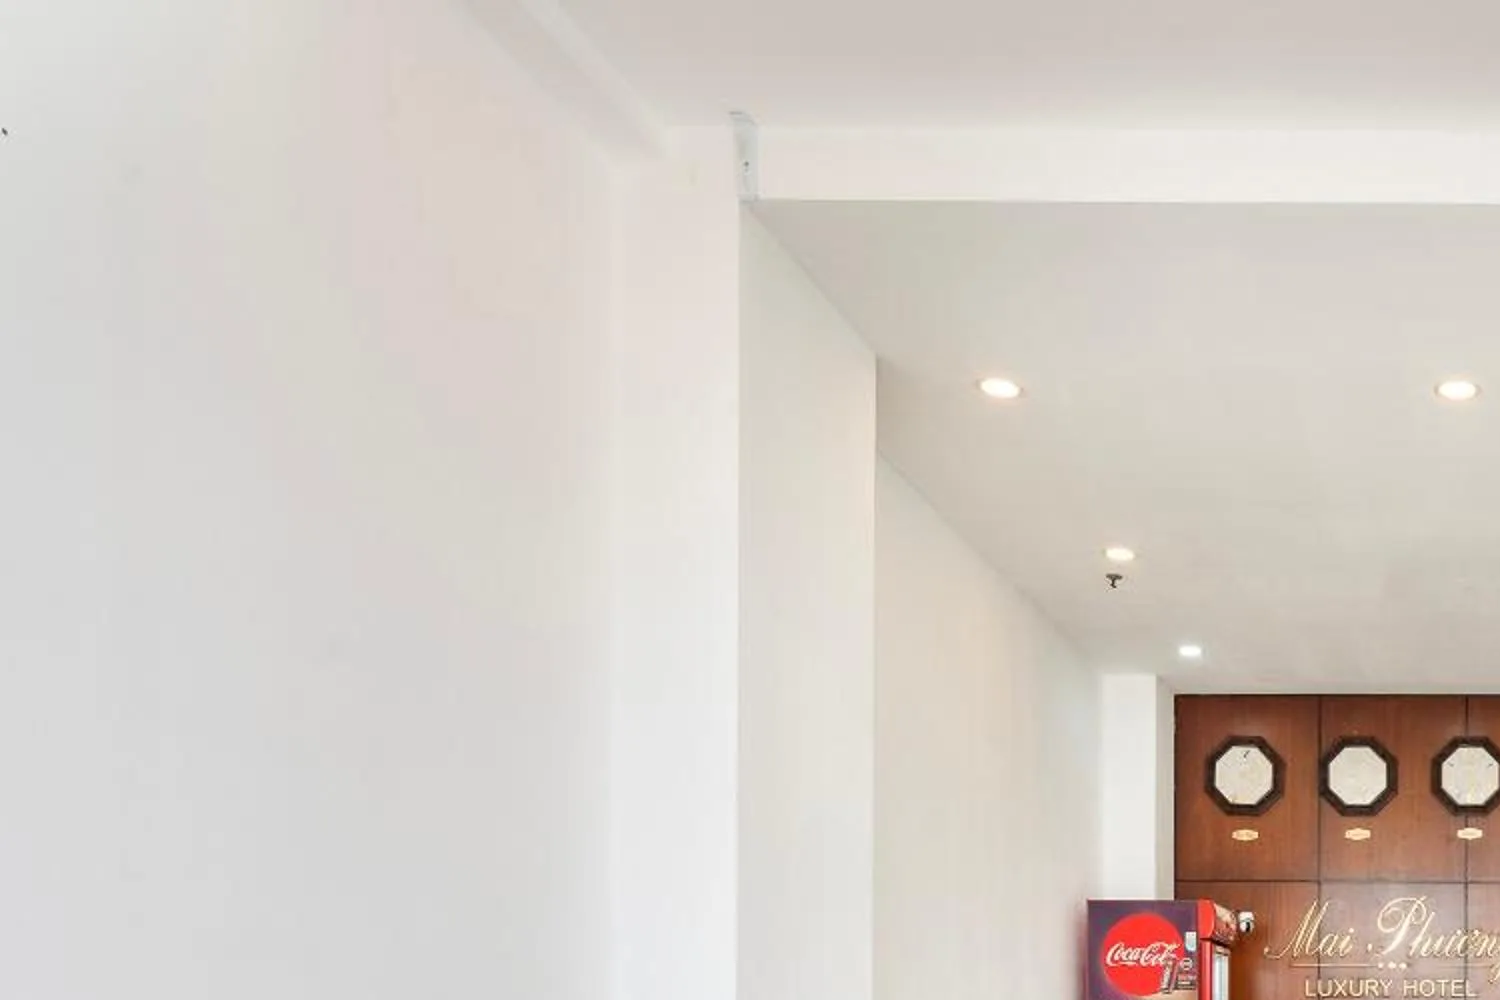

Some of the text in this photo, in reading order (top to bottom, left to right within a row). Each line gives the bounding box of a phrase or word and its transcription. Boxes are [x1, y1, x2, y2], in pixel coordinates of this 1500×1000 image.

[1264, 898, 1354, 960] Mai
[1305, 979, 1478, 998] LUXURY HOTEL
